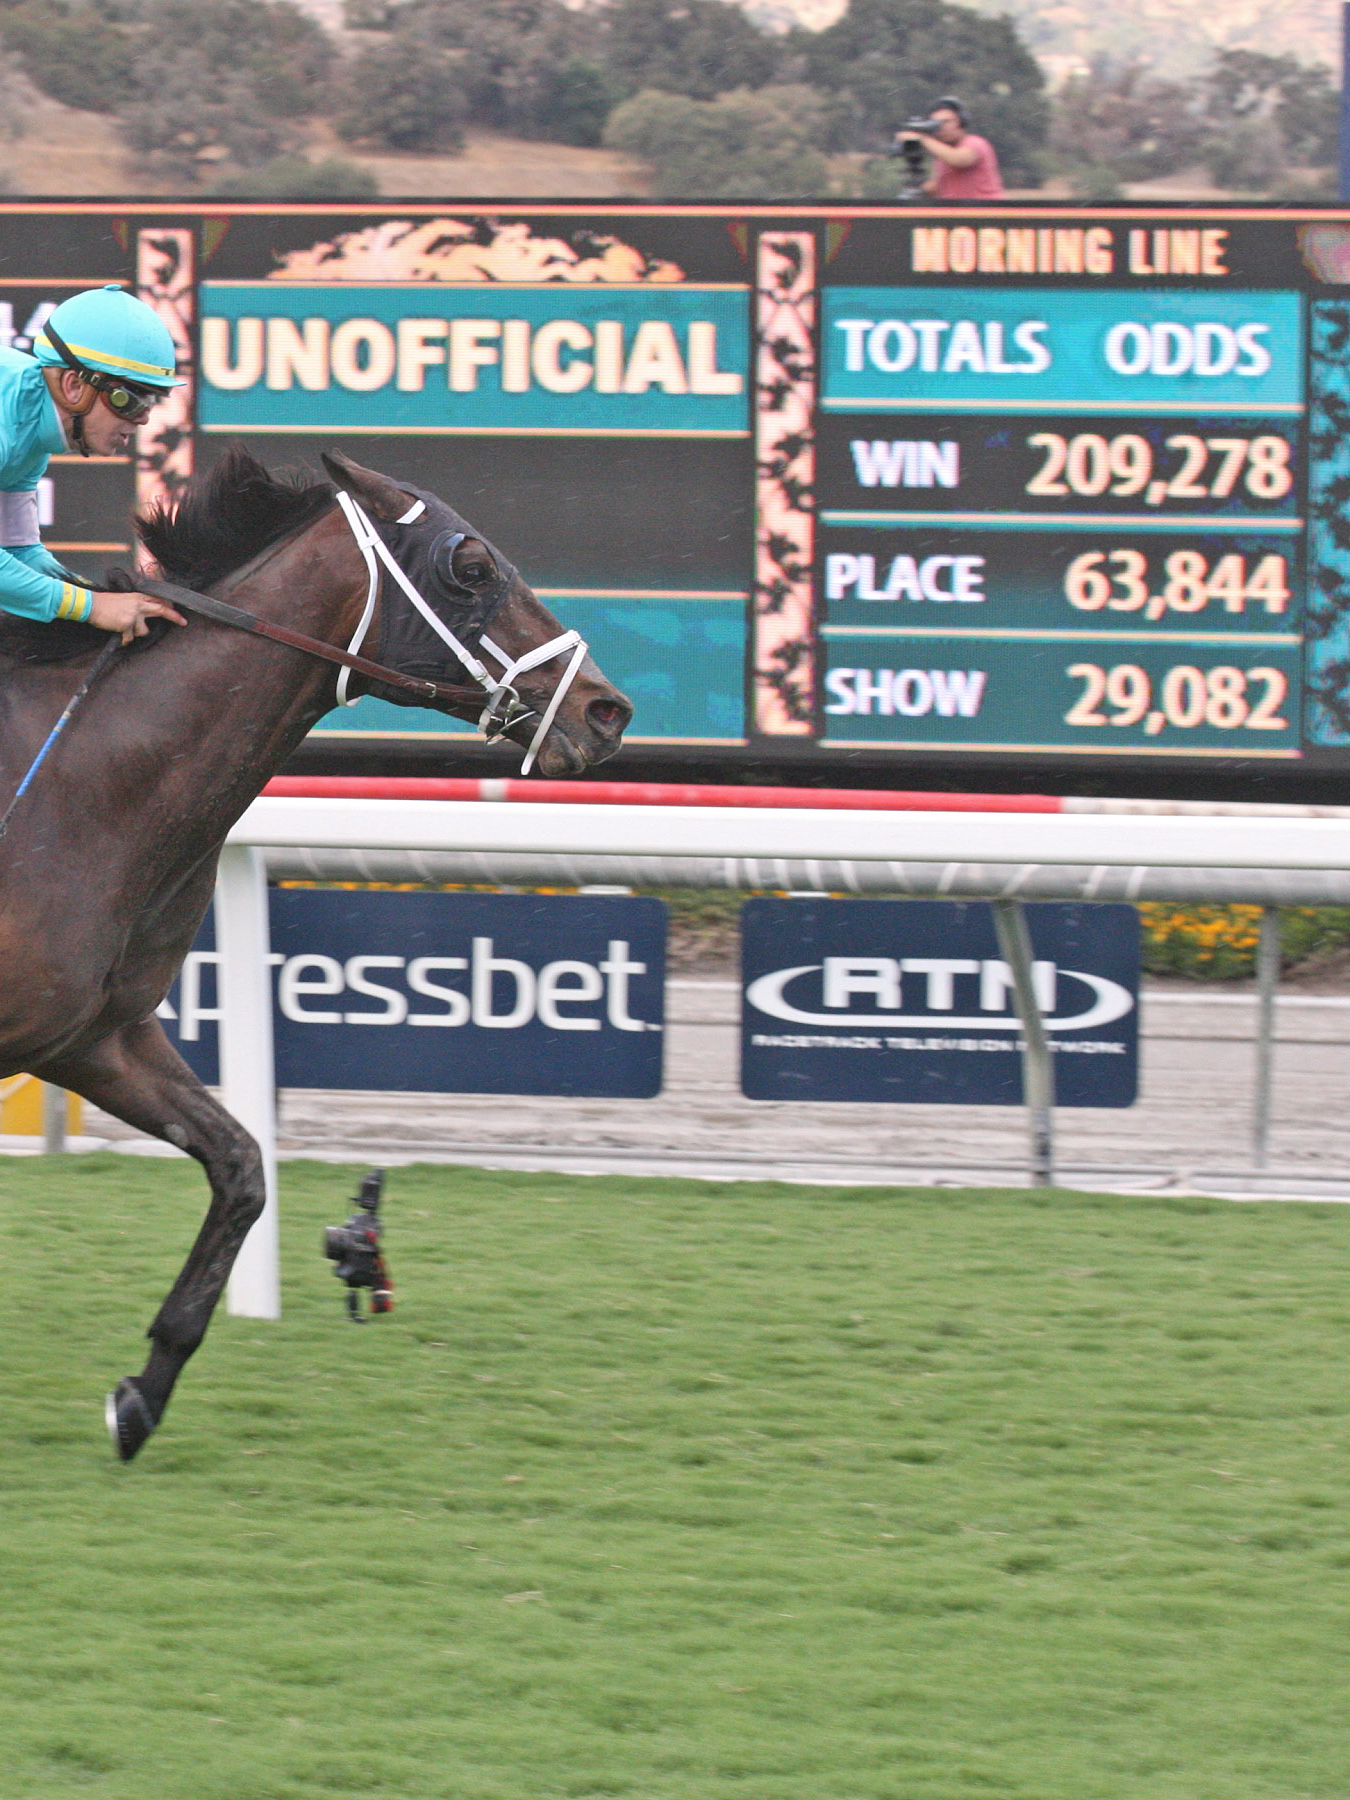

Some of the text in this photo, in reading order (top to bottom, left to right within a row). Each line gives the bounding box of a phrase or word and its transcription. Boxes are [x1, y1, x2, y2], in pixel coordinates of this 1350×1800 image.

[912, 227, 1230, 275] MORNING LINE
[202, 316, 743, 394] UNOFFICIAL
[835, 319, 1271, 376] TOTALS ODDS
[852, 432, 1293, 506] WIN 209,278
[825, 548, 1291, 621] PLACE 63,844
[825, 663, 1289, 736] SHOW 29,082
[822, 956, 1057, 1013] RTN
